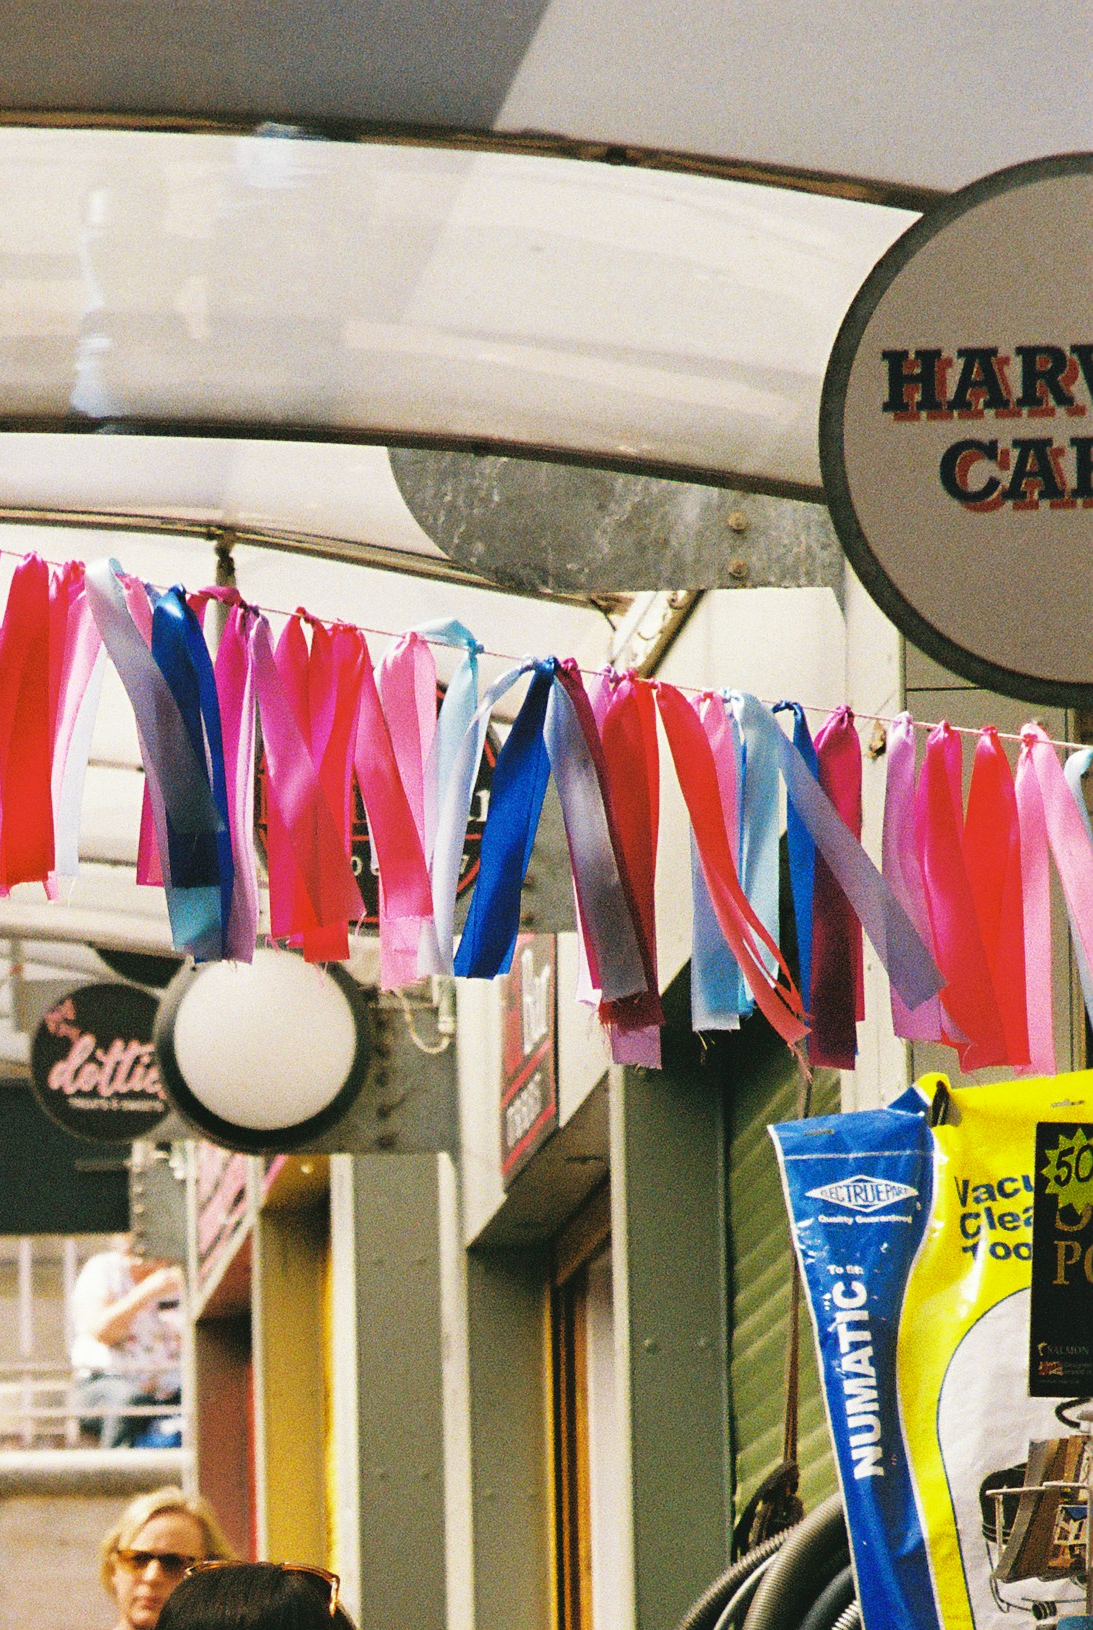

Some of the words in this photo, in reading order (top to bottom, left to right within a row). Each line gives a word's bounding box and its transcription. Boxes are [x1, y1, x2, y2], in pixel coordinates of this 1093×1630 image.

[47, 1031, 166, 1098] dottie
[818, 1214, 854, 1225] Quality
[855, 1214, 913, 1224] Guaranteed
[827, 1264, 845, 1275] To
[832, 1281, 885, 1480] NUMATIC
